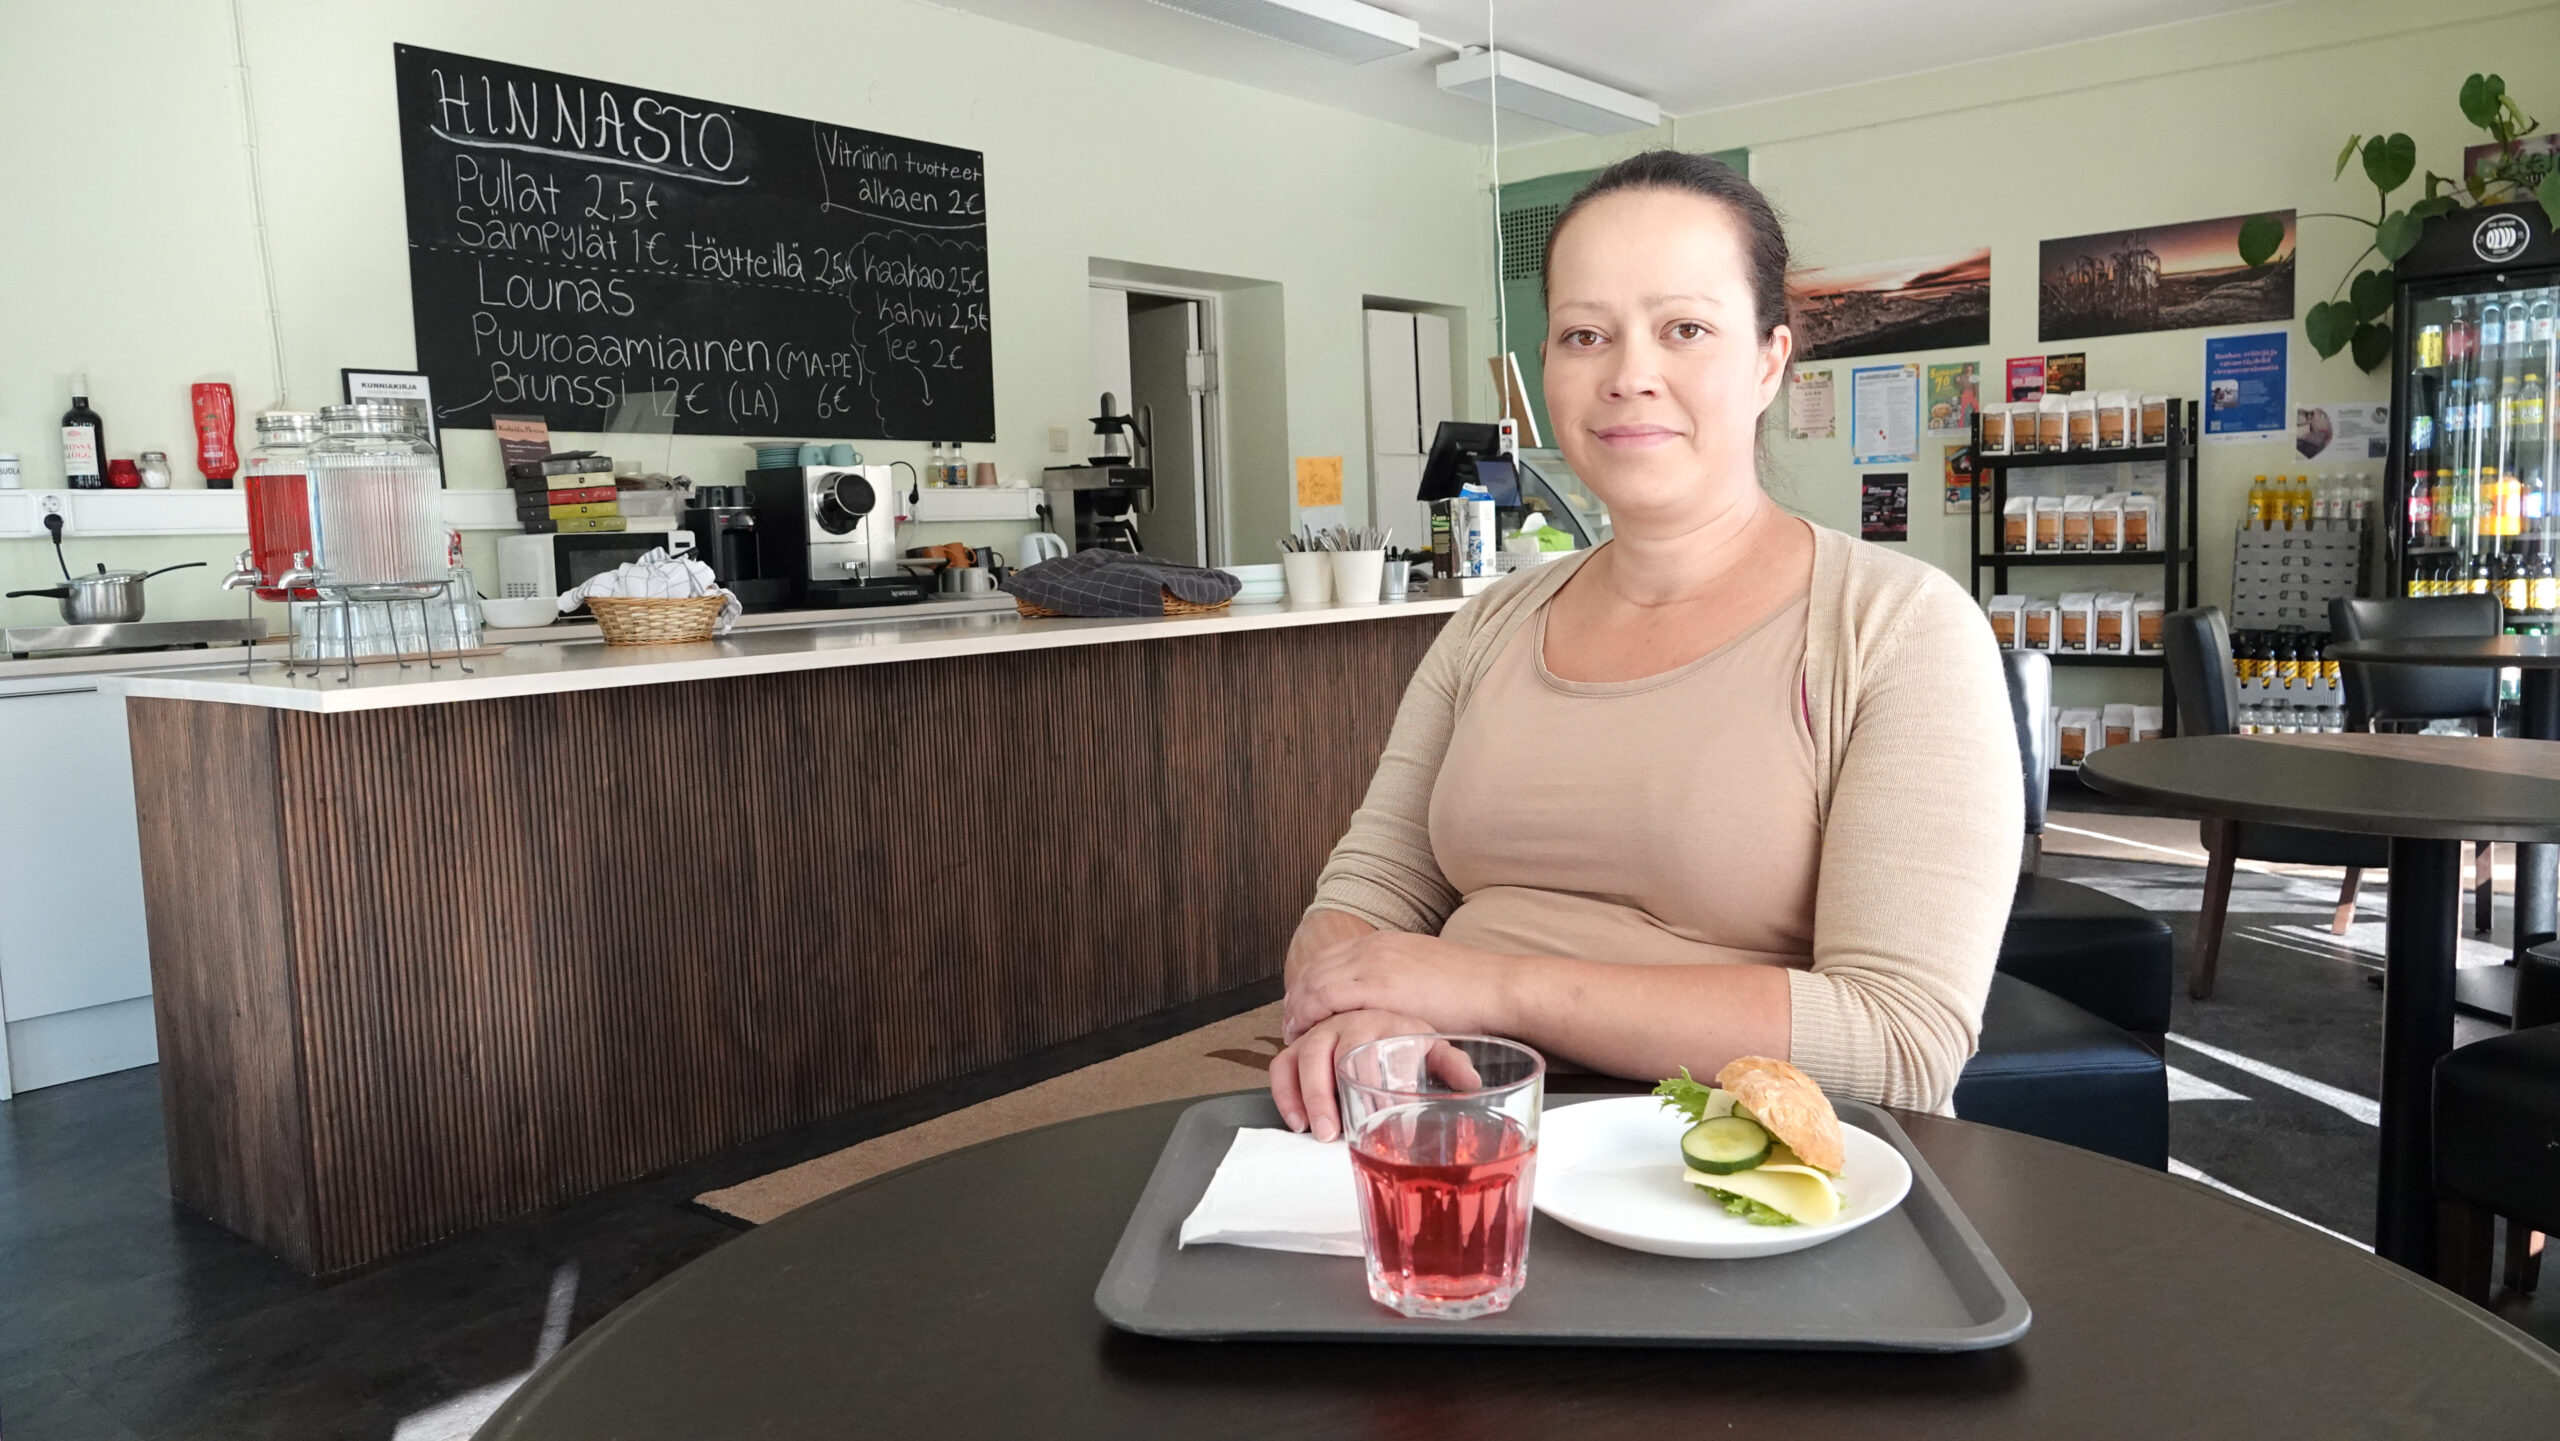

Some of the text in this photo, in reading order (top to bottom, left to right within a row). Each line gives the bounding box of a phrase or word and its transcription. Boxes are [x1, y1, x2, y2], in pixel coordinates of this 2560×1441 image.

[431, 69, 733, 171] HINNASTO
[822, 130, 983, 181] Vitriinin tuotteet
[456, 154, 659, 222] Pullat 2,5€
[859, 177, 984, 214] alkaen 2€
[456, 206, 617, 260] Sämpylät
[684, 231, 806, 283] täytteillä
[478, 260, 634, 316] Lounas
[948, 266, 985, 298] 2,5€
[949, 302, 988, 334] 2,5€
[472, 311, 863, 386] Puuroaamiainen (MA-PE)
[877, 322, 964, 369] Tee 2€
[361, 382, 417, 390] KUNNIAKIRJA
[491, 361, 627, 408] Brunssi
[729, 380, 778, 424] (LA)
[817, 382, 850, 418] 6€
